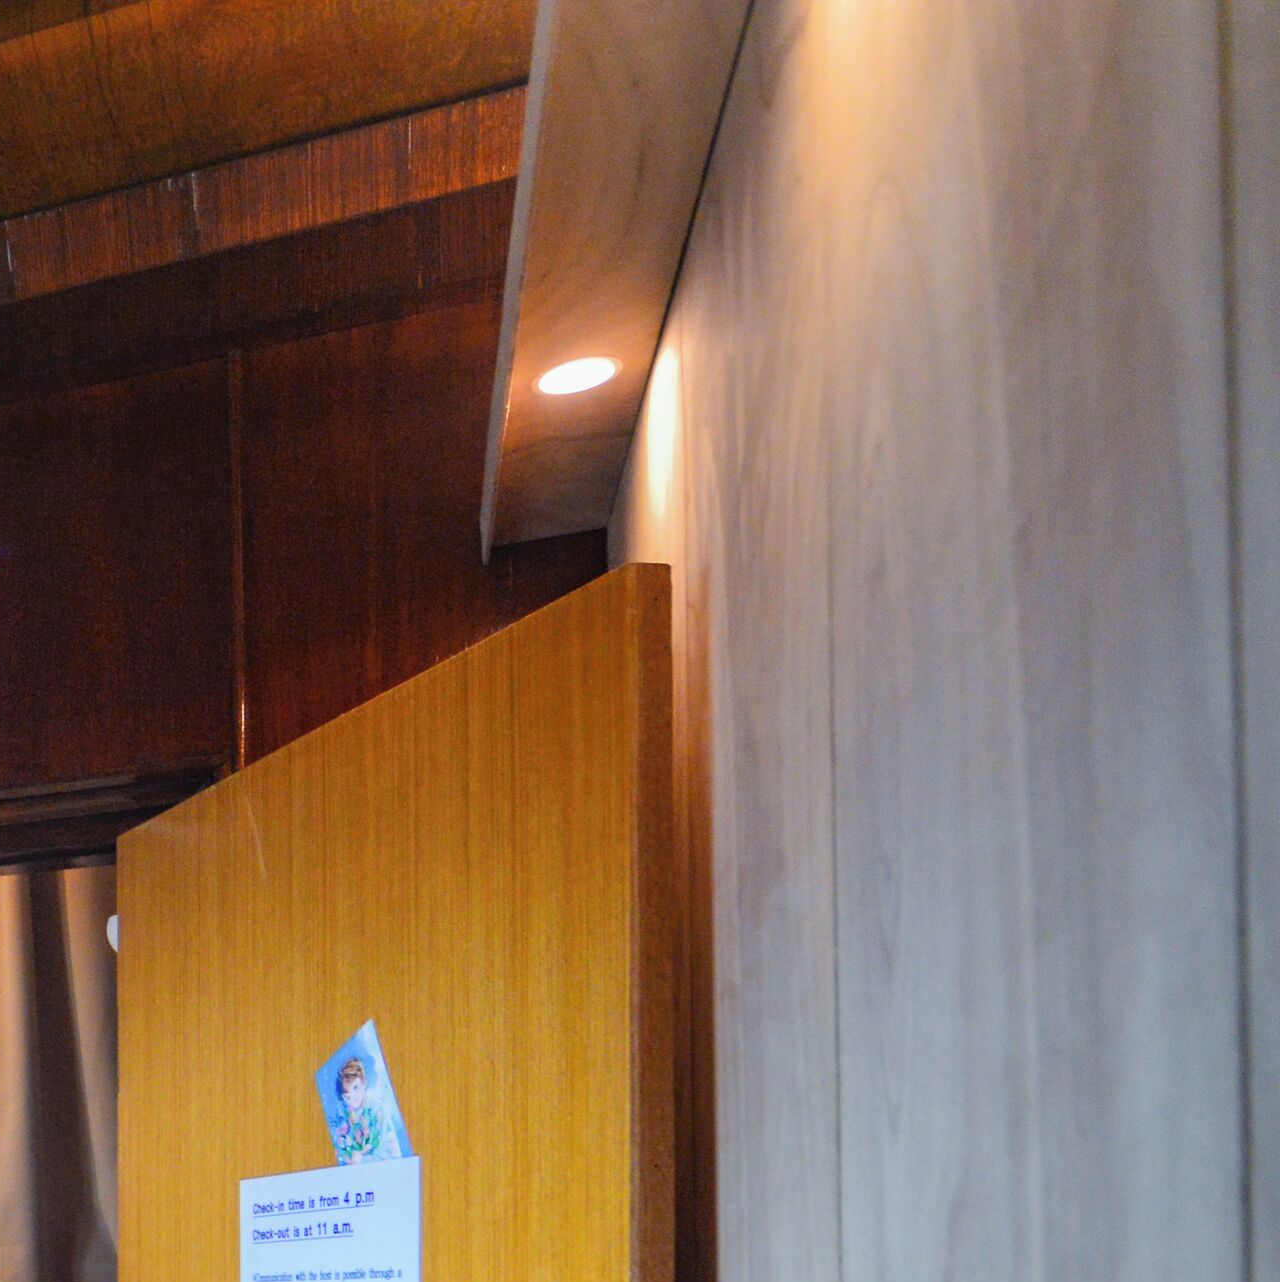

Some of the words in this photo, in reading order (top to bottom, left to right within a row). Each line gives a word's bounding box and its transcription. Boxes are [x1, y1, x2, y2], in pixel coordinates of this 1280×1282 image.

[253, 1199, 285, 1215] Check-in
[288, 1198, 305, 1210] time
[308, 1197, 315, 1209] is
[319, 1195, 339, 1208] from
[343, 1191, 350, 1205] 4
[253, 1226, 290, 1241] Check-out
[293, 1225, 300, 1238] is
[303, 1225, 313, 1237] at
[317, 1221, 328, 1236] 11
[308, 1270, 318, 1282] the
[320, 1269, 332, 1281] host
[334, 1269, 340, 1280] is
[342, 1268, 366, 1282] possible
[369, 1267, 395, 1281] through
[397, 1269, 403, 1278] a
